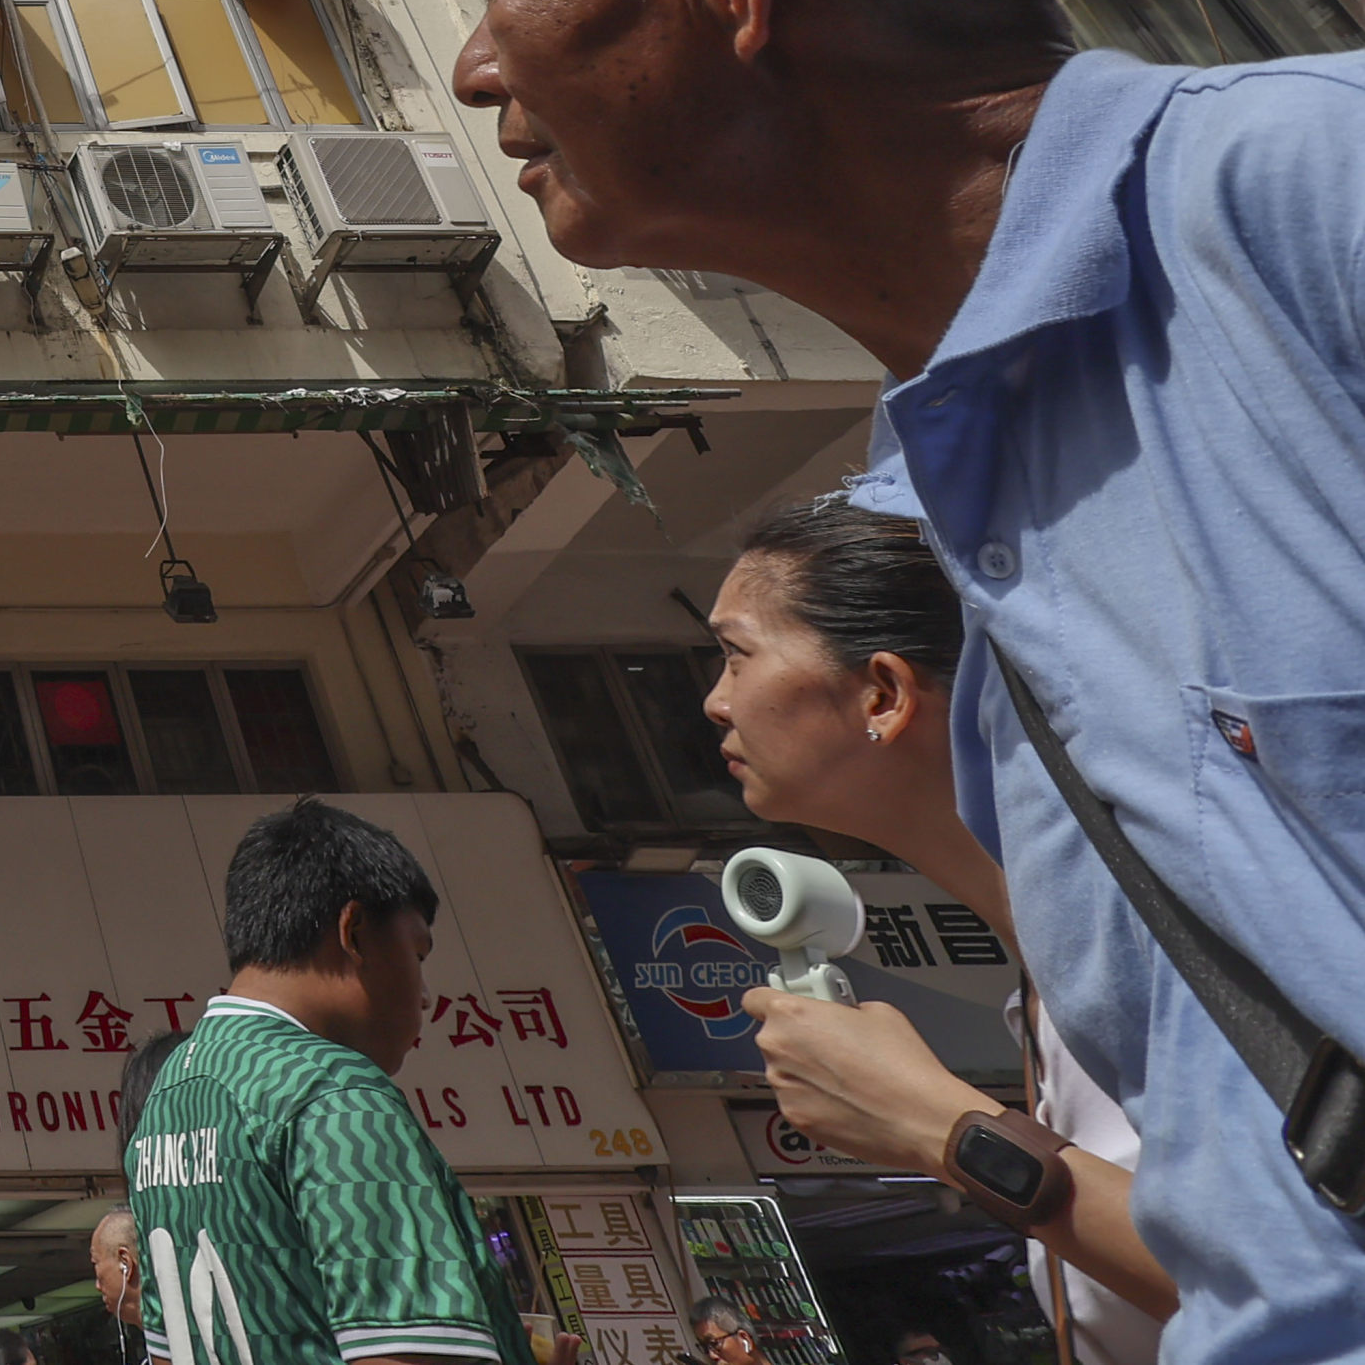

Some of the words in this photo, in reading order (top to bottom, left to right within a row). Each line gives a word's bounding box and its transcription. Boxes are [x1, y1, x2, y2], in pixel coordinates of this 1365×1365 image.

[202, 150, 237, 163] Midea
[865, 903, 1009, 968] 新昌
[501, 1085, 583, 1127] LTD
[134, 1131, 190, 1193] ZHANG
[589, 1128, 654, 1157] 248
[549, 1201, 646, 1247] 工具
[572, 1263, 665, 1310] 量具
[597, 1324, 685, 1365] 仪表
